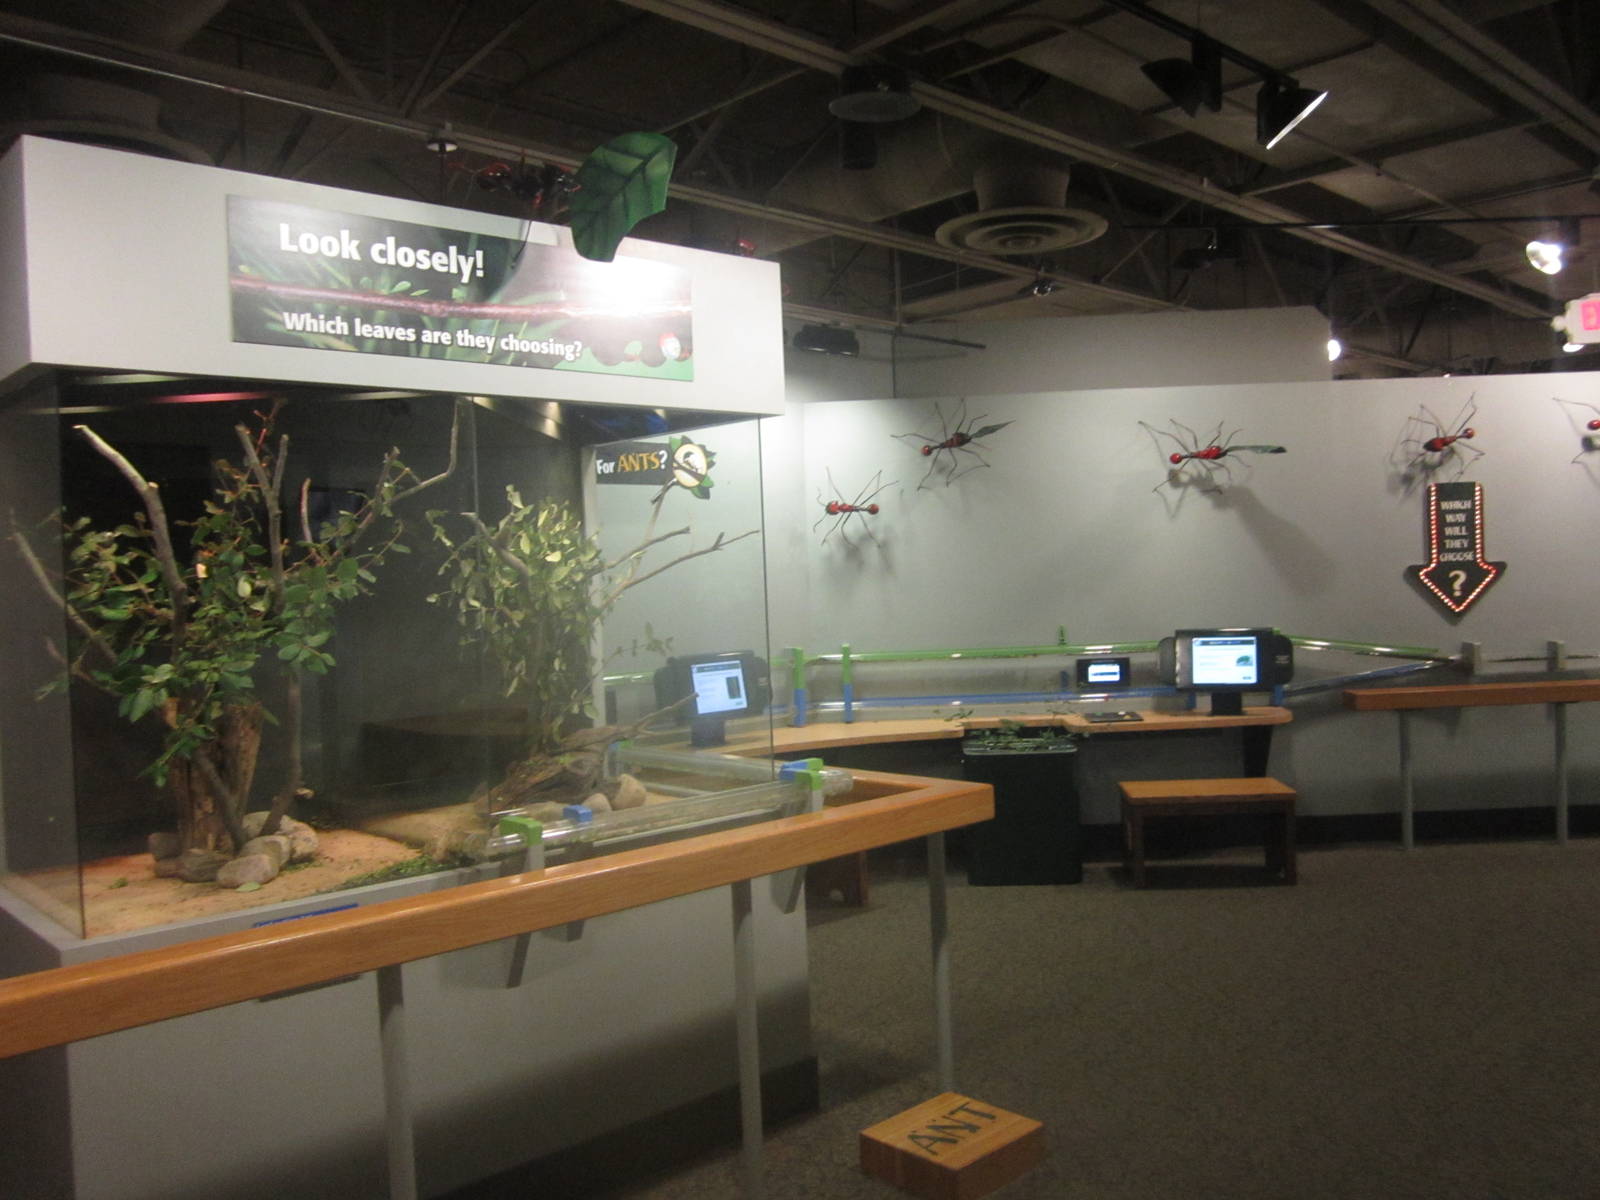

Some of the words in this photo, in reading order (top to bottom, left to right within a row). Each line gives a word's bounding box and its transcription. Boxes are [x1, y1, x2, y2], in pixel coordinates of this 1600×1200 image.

[280, 223, 361, 260] Look
[370, 236, 484, 284] closely!
[283, 311, 349, 335] Which
[354, 317, 416, 341] leaves
[421, 329, 452, 345] are
[456, 329, 495, 353] they
[500, 333, 583, 361] choosing?
[596, 460, 615, 474] For
[618, 450, 668, 472] ANTS?
[1441, 500, 1472, 510] WHICH
[1445, 513, 1467, 523] WAY
[1445, 526, 1468, 536] WILL
[1444, 539, 1469, 549] THEY
[1440, 551, 1474, 562] CHOOSE
[1448, 570, 1468, 597] ?
[908, 1102, 996, 1157] ANT
